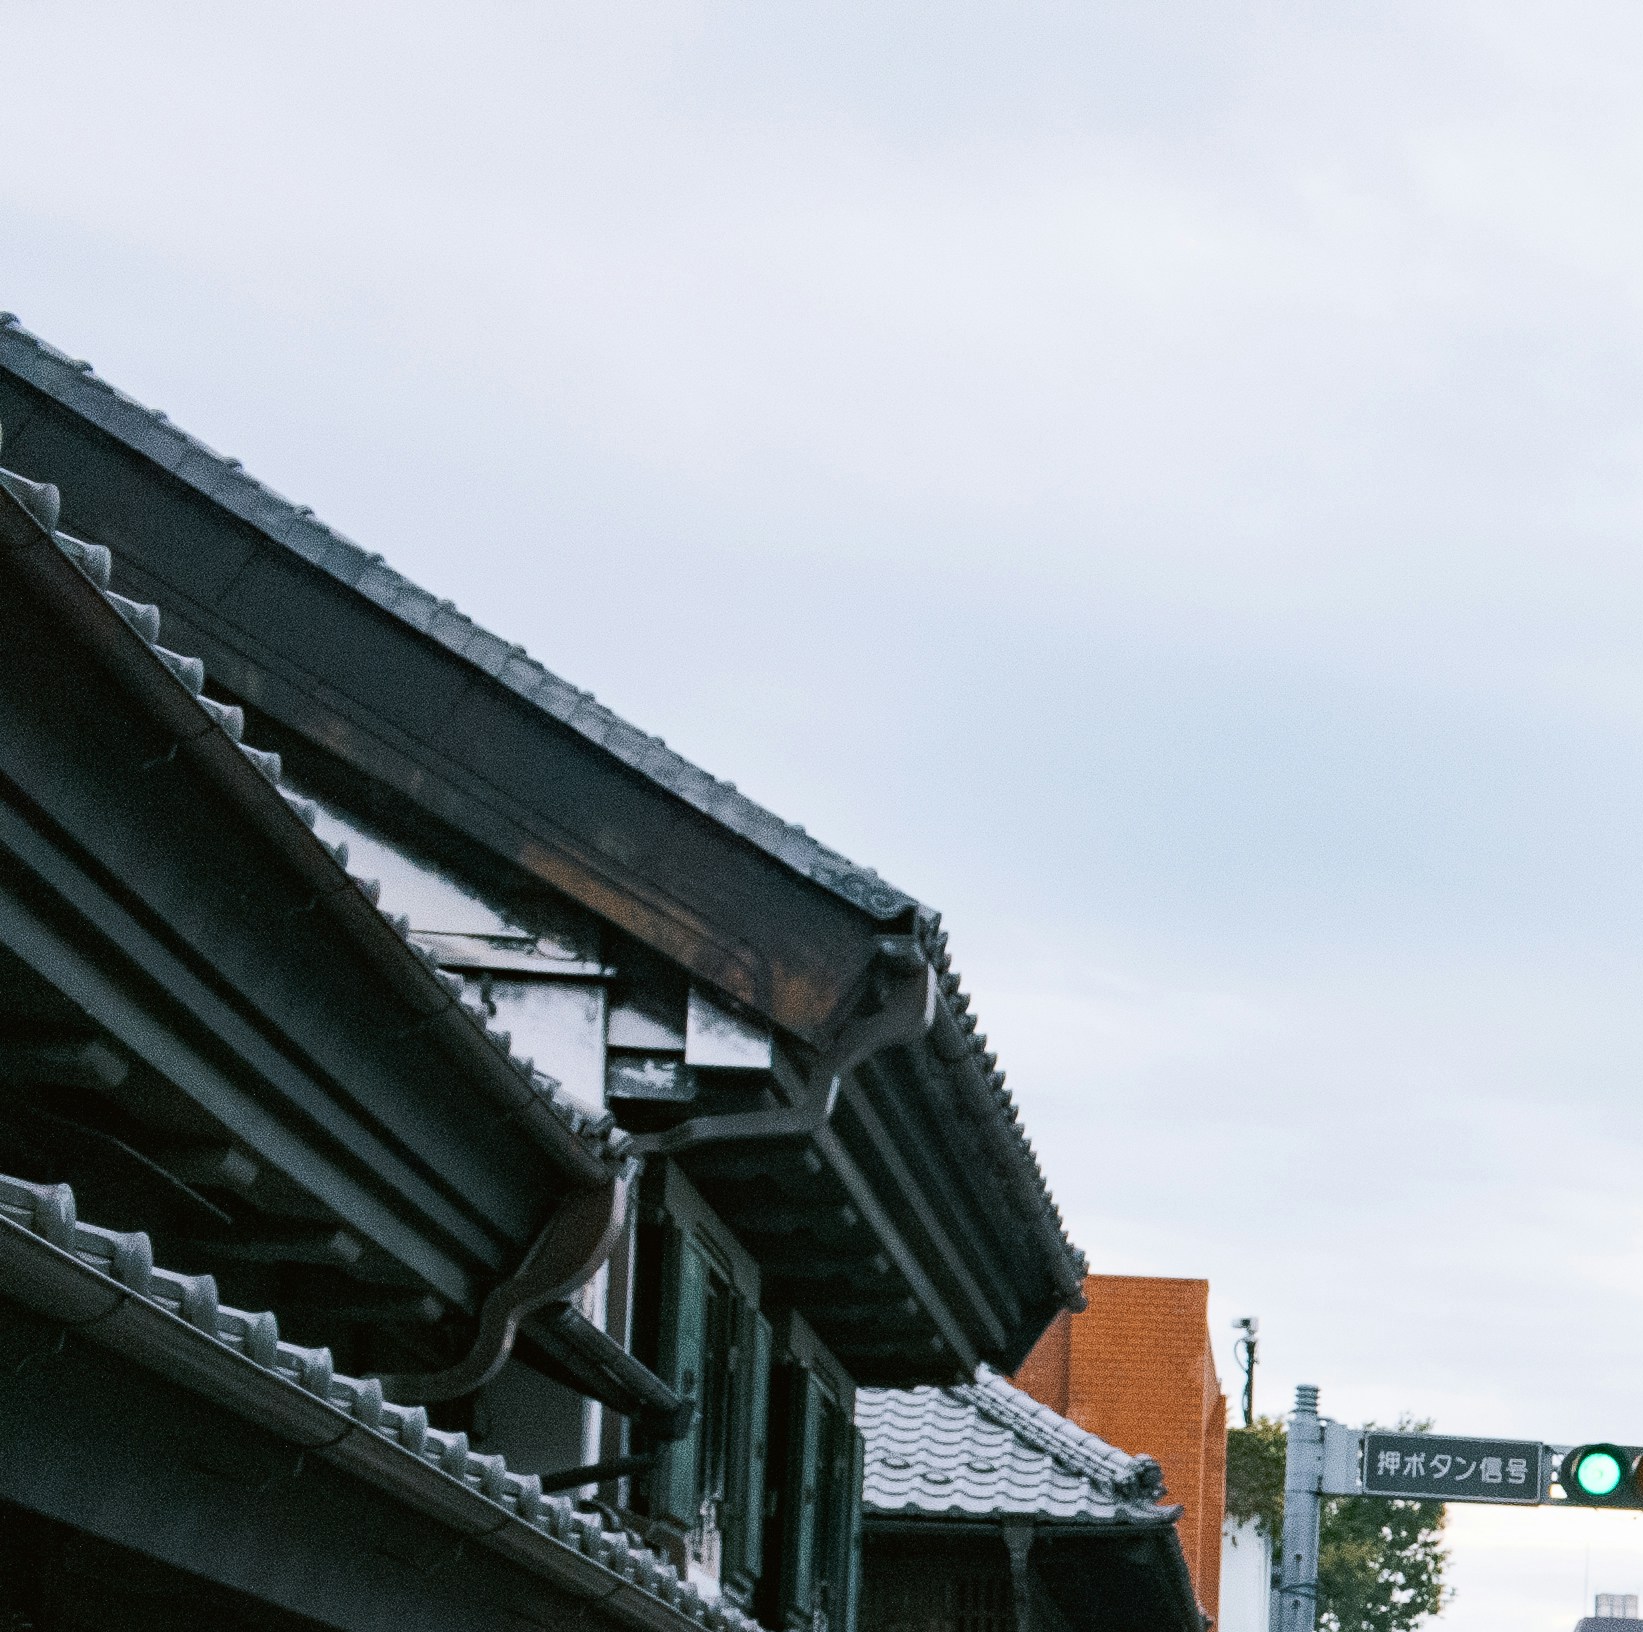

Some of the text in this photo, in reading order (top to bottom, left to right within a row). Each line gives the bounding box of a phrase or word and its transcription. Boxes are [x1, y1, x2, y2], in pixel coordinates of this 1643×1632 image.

[1377, 1450, 1528, 1485] 押ボタン信号
